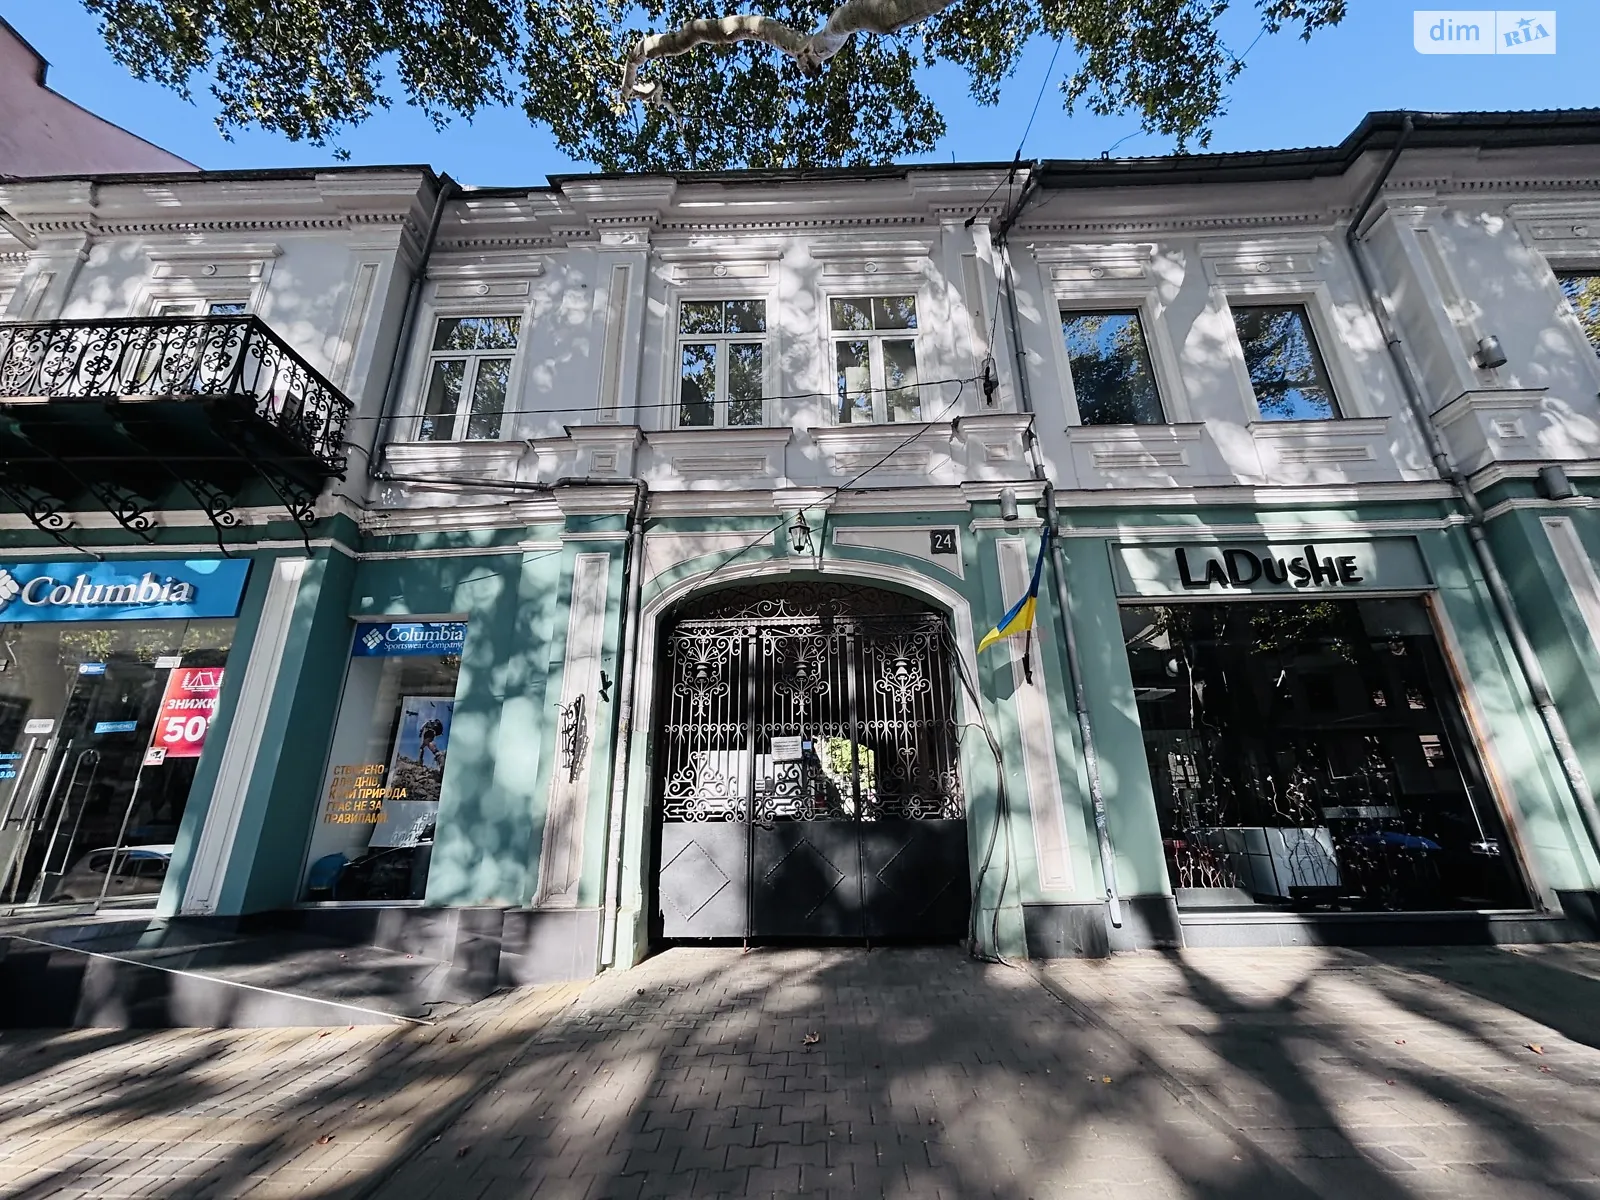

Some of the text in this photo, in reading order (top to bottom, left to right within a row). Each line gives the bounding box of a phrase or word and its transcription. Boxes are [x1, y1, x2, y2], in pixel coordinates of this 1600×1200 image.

[934, 534, 952, 549] 24
[21, 572, 195, 606] Columbia
[385, 626, 464, 642] Columbia
[383, 641, 426, 652] Sportswear
[358, 787, 407, 799] ПРИРОДА
[353, 801, 369, 811] НЕ
[369, 800, 383, 811] ЗА
